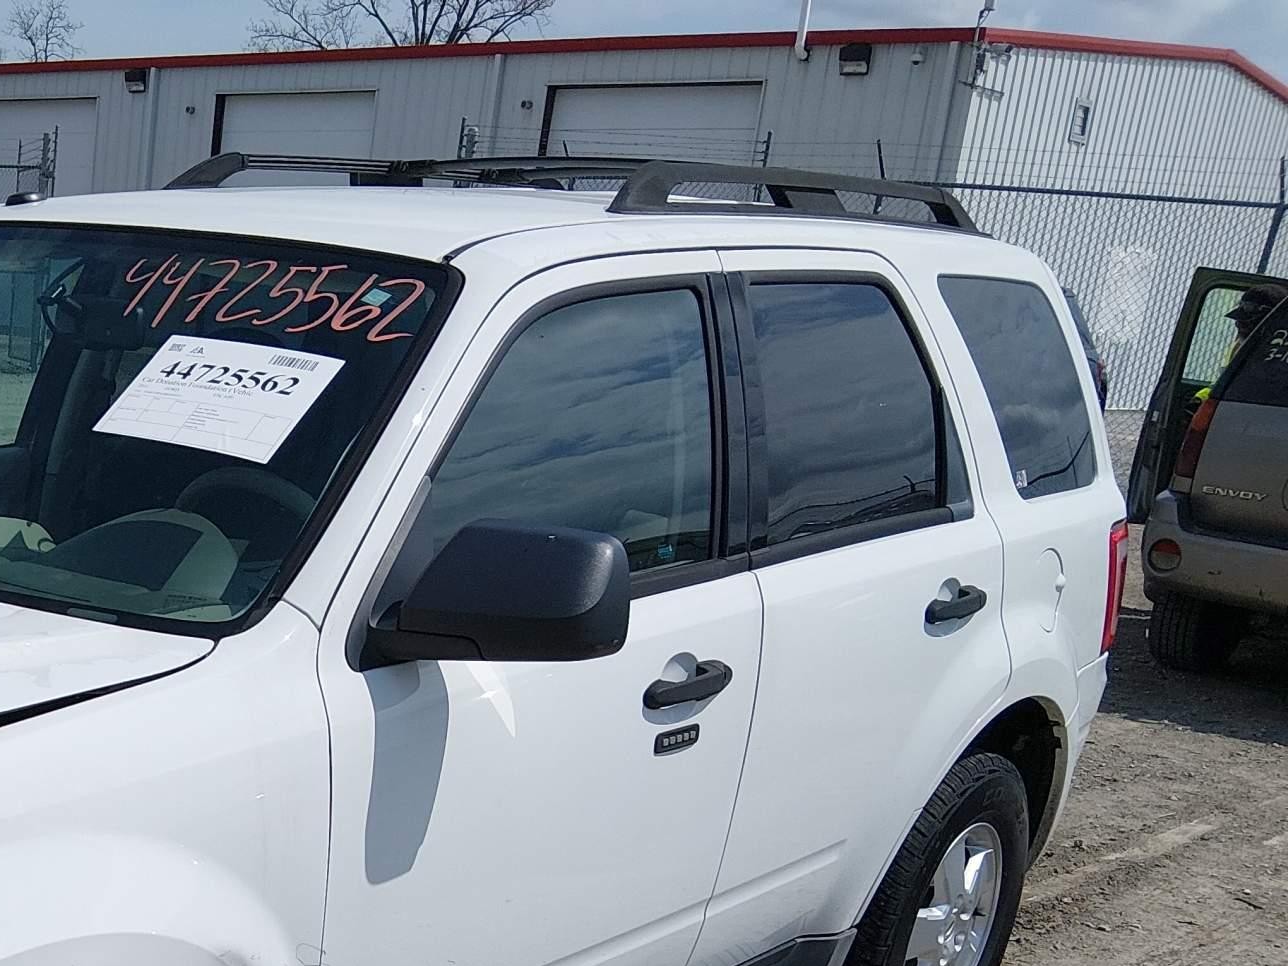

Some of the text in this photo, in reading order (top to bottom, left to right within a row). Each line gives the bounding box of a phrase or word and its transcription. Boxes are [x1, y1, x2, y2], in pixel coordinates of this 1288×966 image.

[123, 254, 426, 342] 44725562
[160, 360, 300, 396] 44725562
[1202, 486, 1267, 500] ENVOY
